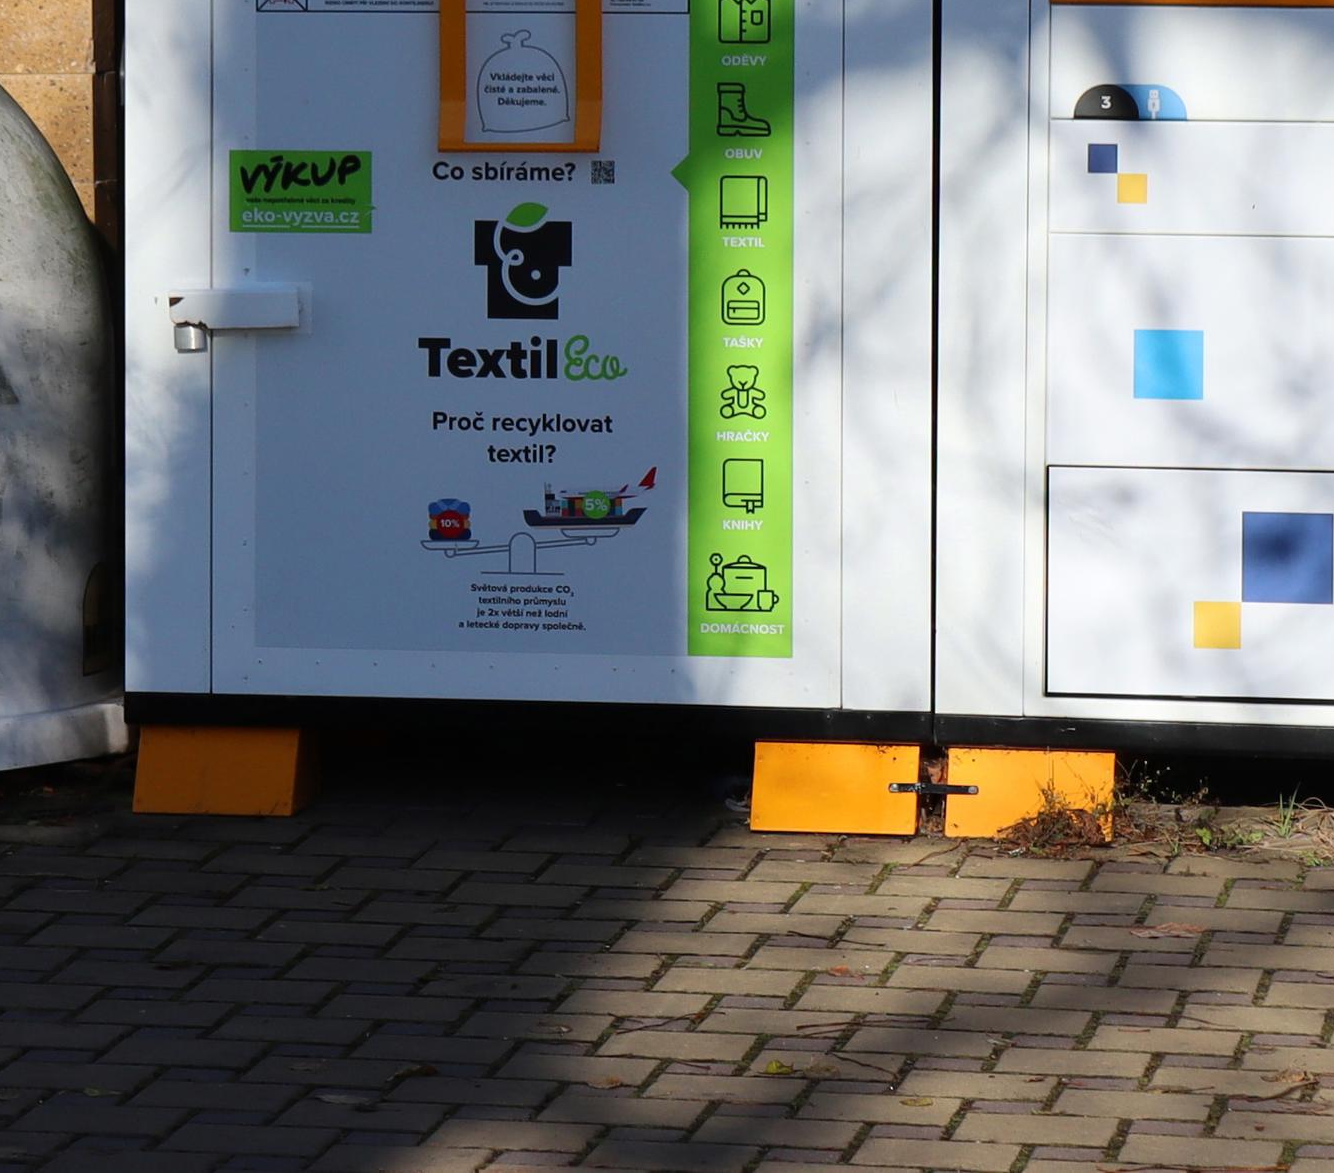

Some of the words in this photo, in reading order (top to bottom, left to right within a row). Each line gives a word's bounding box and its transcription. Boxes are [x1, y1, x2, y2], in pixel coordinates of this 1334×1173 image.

[721, 53, 767, 66] ODĚVY
[490, 73, 534, 84] Vkládejte
[536, 73, 555, 82] věci
[484, 84, 506, 94] čisté
[516, 84, 560, 94] zabalené.
[497, 96, 547, 107] Děkujeme.
[1101, 95, 1112, 109] 3
[724, 148, 763, 159] OBUV
[240, 154, 362, 194] VÝKUP
[432, 161, 465, 182] Co
[471, 160, 576, 183] sbíráme?
[242, 207, 360, 226] eko-vyzva.cz
[721, 236, 765, 248] TEXTIL
[722, 334, 764, 349] TAŠKY
[432, 409, 485, 432] Proč
[492, 410, 613, 438] recyklovat
[716, 428, 770, 442] HRAČKY
[487, 441, 557, 465] textil?
[585, 499, 608, 512] 5%
[440, 518, 460, 529] 10%
[722, 519, 764, 531] KNIHY
[470, 583, 508, 593] Světová
[510, 584, 553, 596] produkce
[478, 595, 521, 605] textilního
[523, 596, 566, 608] průmyslu
[476, 608, 485, 618] je
[488, 608, 499, 617] 2x
[501, 607, 524, 617] větší
[526, 608, 542, 618] než
[544, 608, 568, 619] lodní
[466, 619, 500, 630] letecké
[502, 620, 540, 632] dopravy
[542, 621, 586, 633] společně.
[700, 621, 785, 636] DOMÁCNOST
